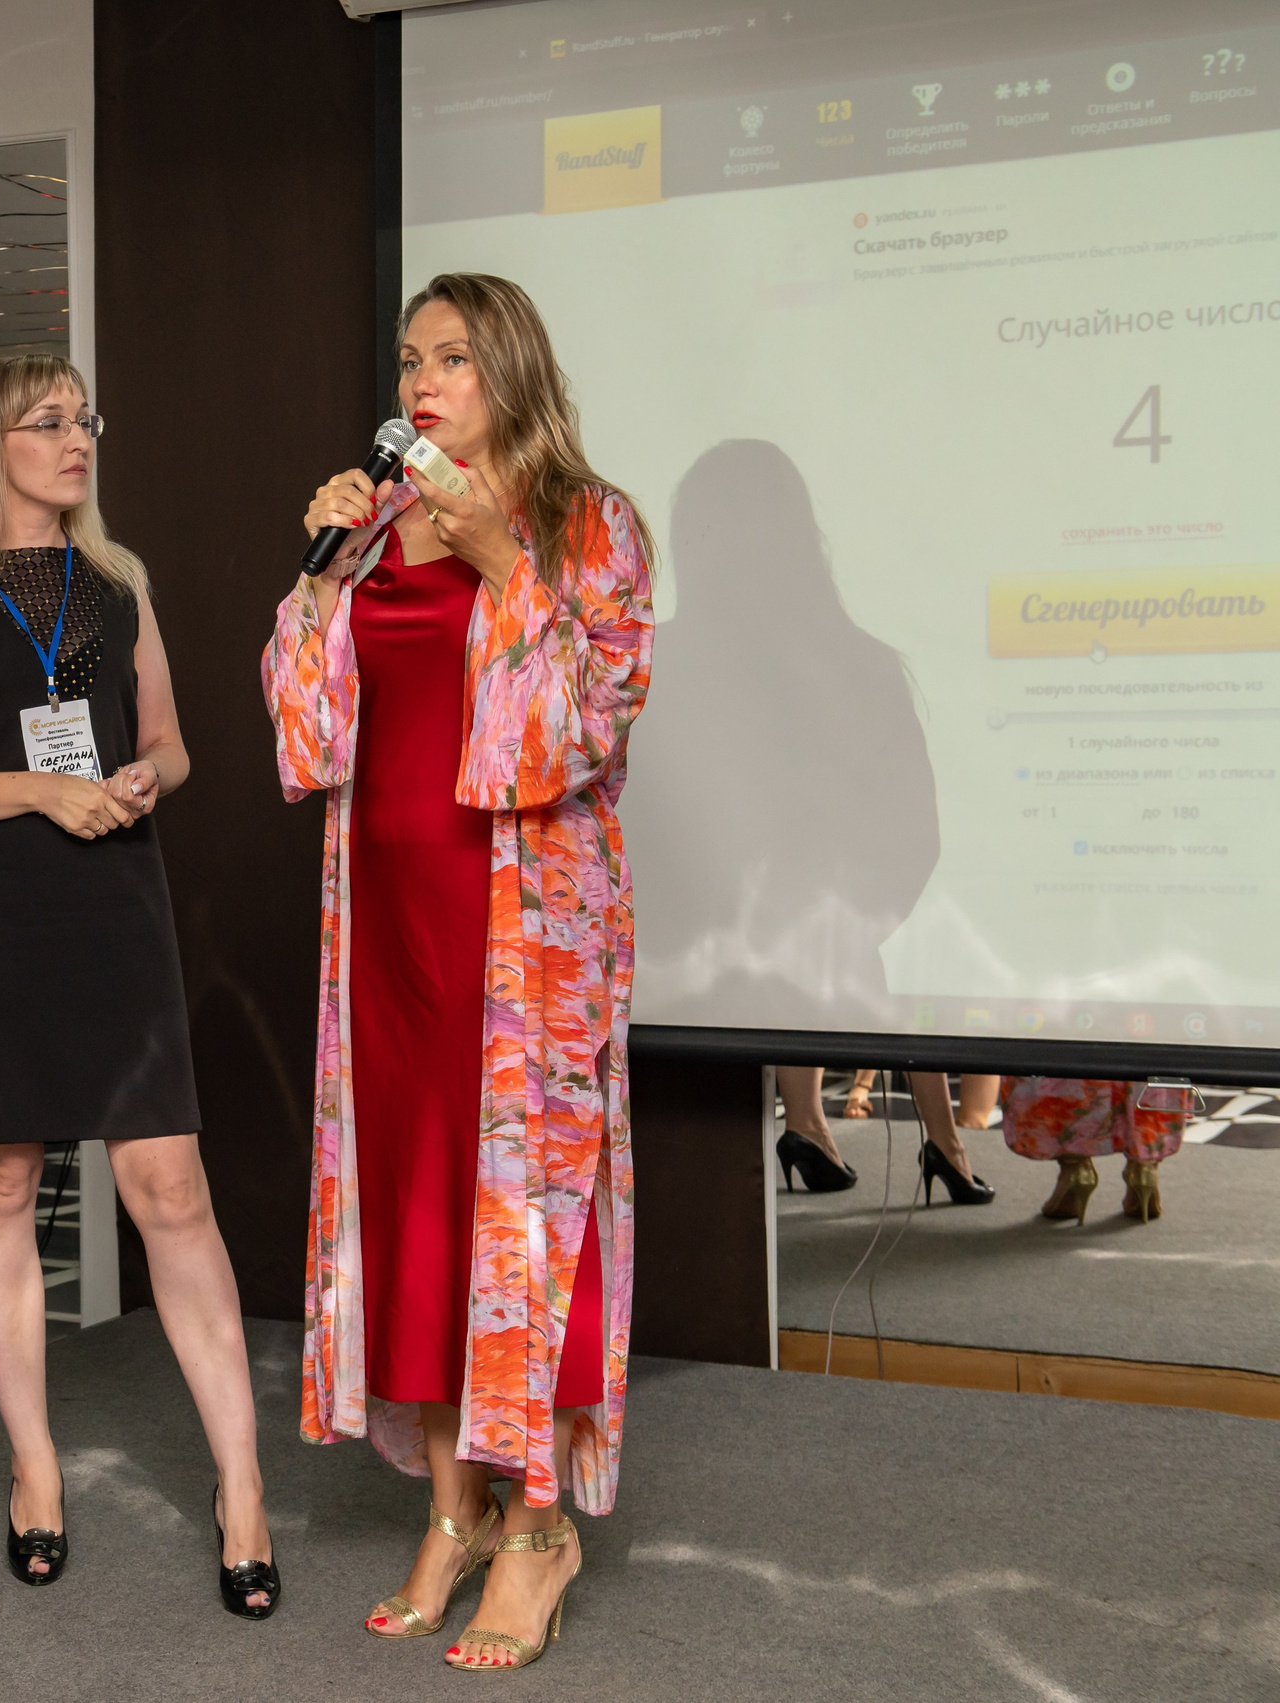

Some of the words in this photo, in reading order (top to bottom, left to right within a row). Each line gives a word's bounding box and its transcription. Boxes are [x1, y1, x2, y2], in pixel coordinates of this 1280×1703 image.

[644, 28, 702, 44] Генератор
[1189, 87, 1256, 103] Вопросы
[816, 99, 852, 124] 123
[1088, 100, 1141, 116] Ответы
[1145, 98, 1155, 108] и
[996, 112, 1049, 127] Пароли
[1071, 113, 1172, 137] предсказания
[886, 121, 968, 140] Определить
[555, 141, 647, 171] RandStuff
[729, 145, 775, 158] Колесо
[887, 138, 967, 156] победителя
[723, 160, 780, 177] фортуны
[875, 209, 936, 226] yandex.ru
[853, 236, 926, 255] Скачать
[930, 228, 1008, 249] браузер
[998, 307, 1174, 348] Случайное
[1186, 299, 1280, 328] число
[1112, 384, 1173, 464] 4
[1061, 524, 1143, 542] сохранить
[1147, 523, 1172, 536] это
[1177, 520, 1224, 535] число
[1021, 587, 1266, 629] Сгенерировать
[1025, 685, 1074, 699] новую
[1078, 681, 1241, 696] последовательность
[1246, 681, 1263, 692] из
[48, 741, 74, 750] Партнер
[1068, 737, 1075, 748] 1
[1079, 735, 1169, 752] случайного
[1174, 736, 1220, 749] числа
[40, 748, 93, 767] СВЕТЛАНА
[1035, 770, 1053, 781] из
[1056, 769, 1139, 783] диапазона
[1144, 769, 1173, 780] или
[1198, 769, 1217, 780] из
[1221, 767, 1276, 780] списка
[1022, 808, 1039, 819] от
[1050, 807, 1057, 819] 1
[1141, 808, 1161, 821] до
[1172, 806, 1200, 820] 180
[1092, 843, 1177, 856] исключить
[1182, 844, 1229, 857] числа
